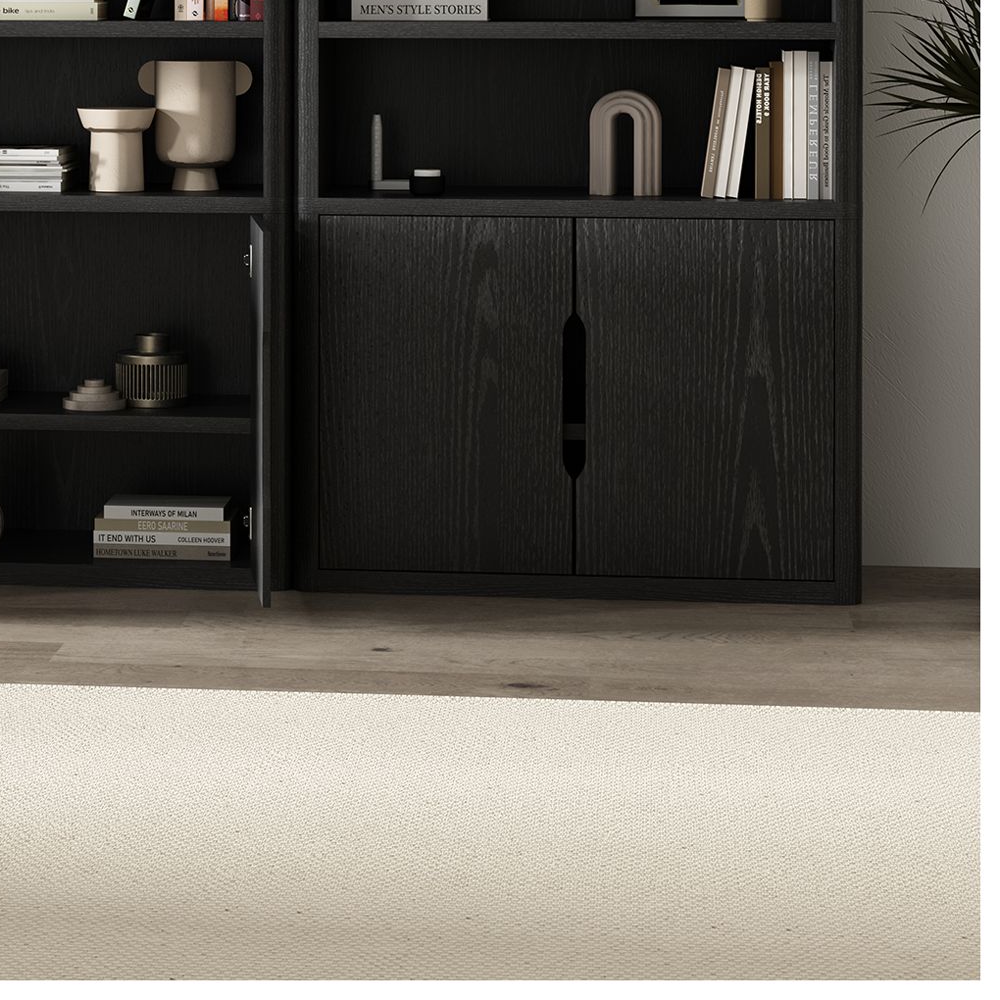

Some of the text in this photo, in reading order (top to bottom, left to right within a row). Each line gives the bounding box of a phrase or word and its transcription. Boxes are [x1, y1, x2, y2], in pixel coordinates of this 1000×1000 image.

[360, 5, 482, 14] MEN'S STYLE STORIES
[130, 509, 198, 518] INTERWAYS OF MILAN
[138, 521, 157, 530] EERO
[98, 534, 105, 542] IT
[107, 534, 123, 542] END
[124, 534, 144, 543] WITH
[145, 535, 156, 544] US
[96, 548, 177, 557] HOMETOWN LUKE WALKER
